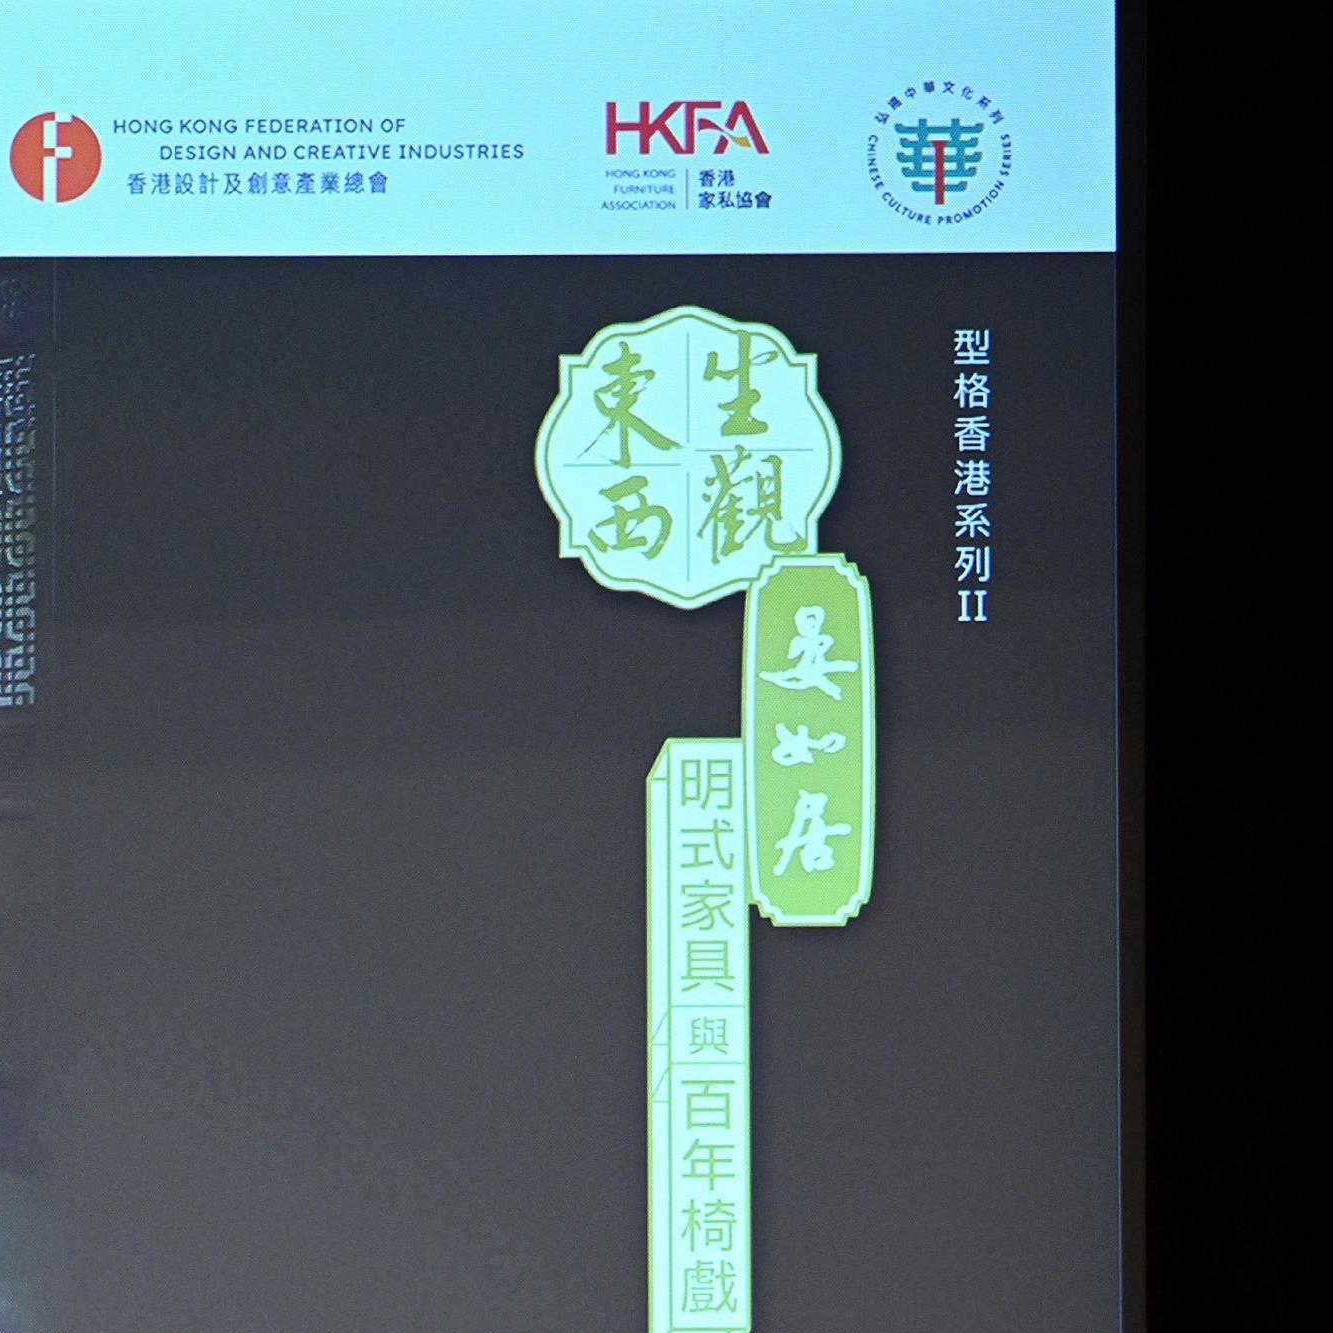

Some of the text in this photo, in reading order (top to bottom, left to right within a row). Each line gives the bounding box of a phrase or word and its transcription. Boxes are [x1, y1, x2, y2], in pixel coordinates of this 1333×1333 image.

[114, 118, 405, 134] HONG KONG FEDERATION OF
[606, 101, 769, 155] HKFA
[160, 144, 524, 160] DESIGN AND CREATIVE INDUSTRIES
[606, 169, 676, 178] HONG KONG
[699, 170, 735, 187] 香港
[128, 171, 387, 195] 香港設計及創意產業總會
[614, 185, 674, 194] FURNITURE
[601, 200, 676, 210] ASSOCIATION
[699, 191, 772, 209] 家私協會
[882, 191, 931, 224] CULTURE
[937, 180, 1005, 225] PROMOTION
